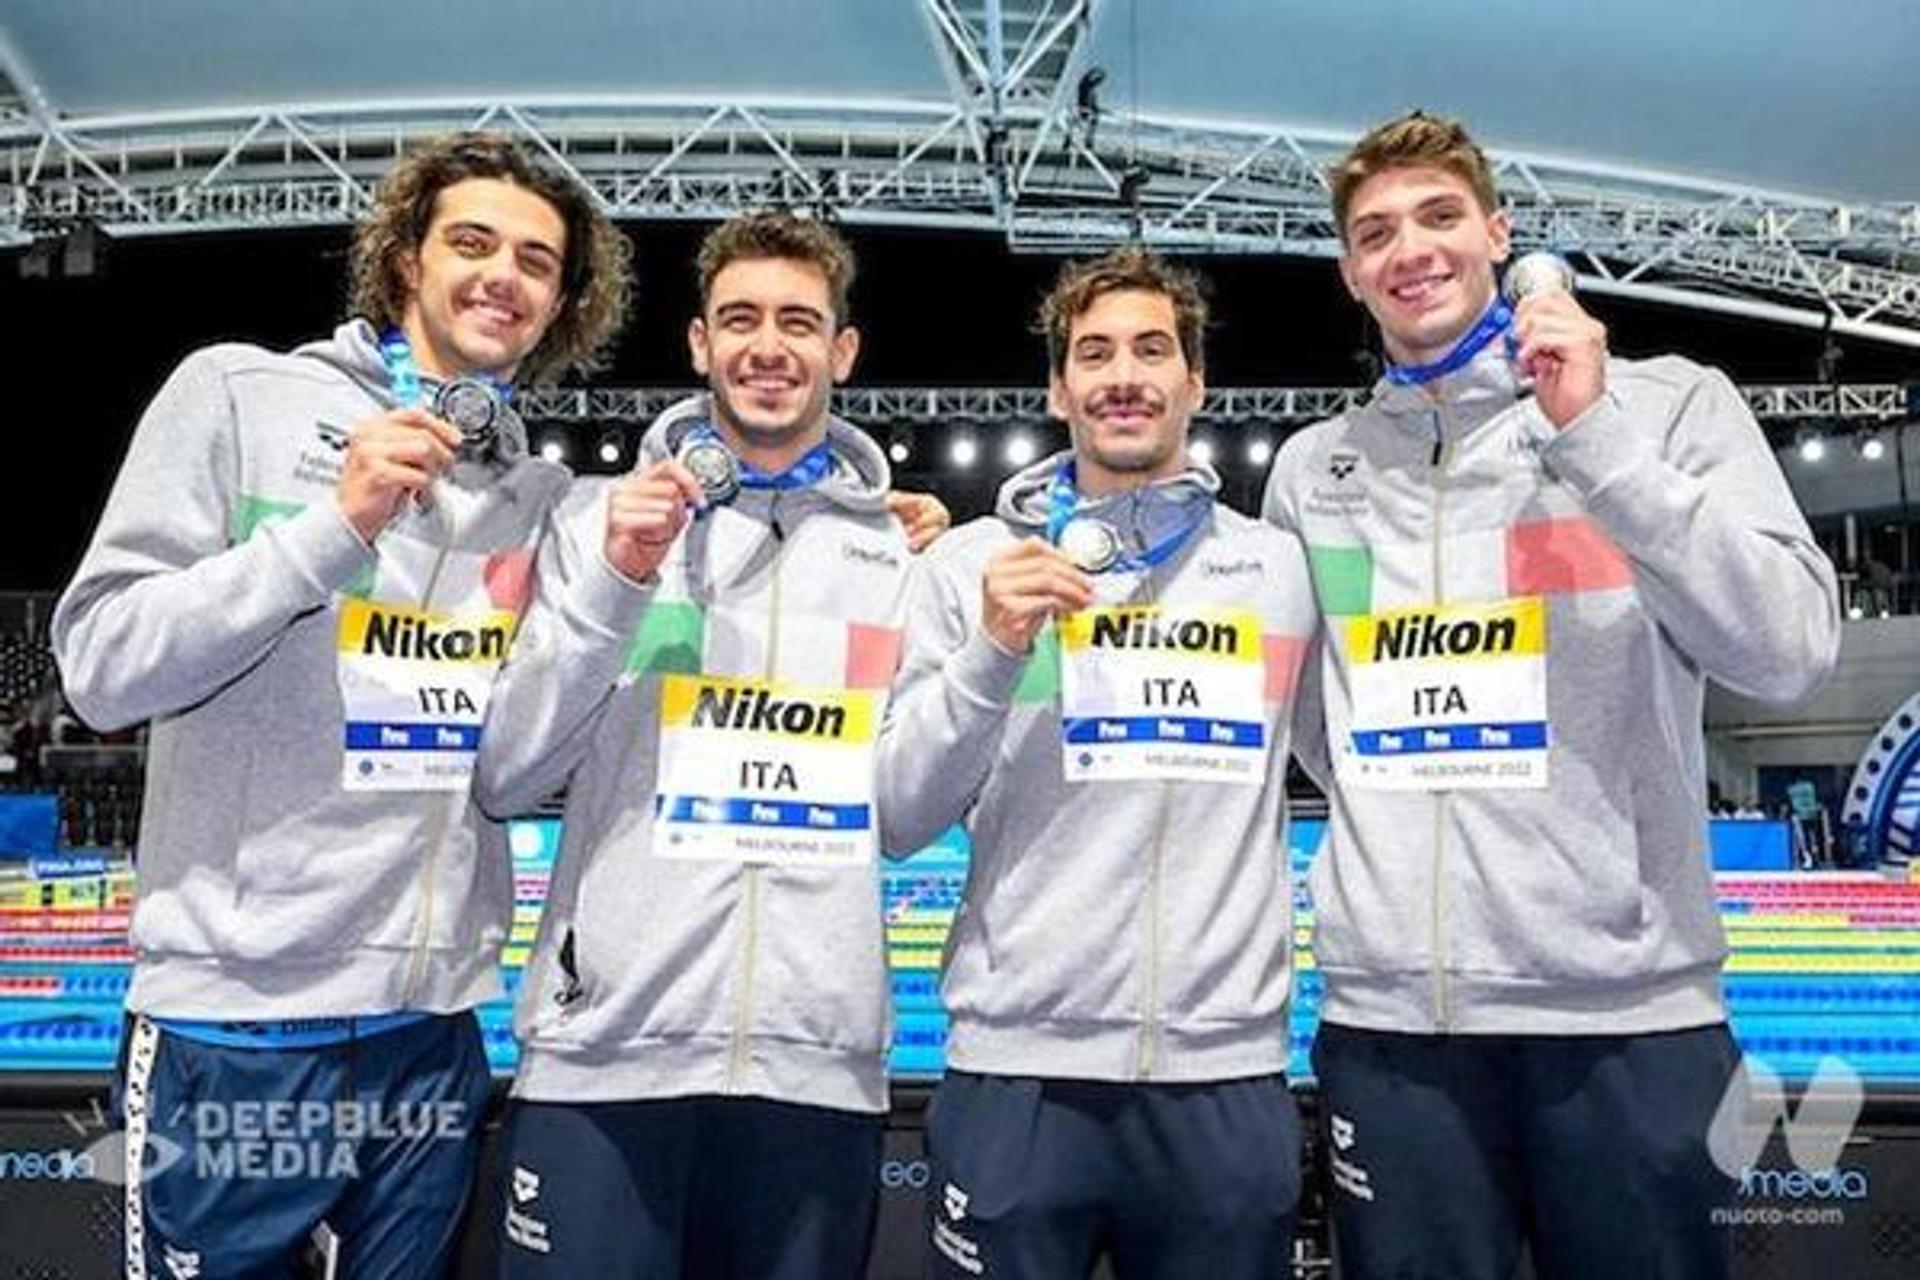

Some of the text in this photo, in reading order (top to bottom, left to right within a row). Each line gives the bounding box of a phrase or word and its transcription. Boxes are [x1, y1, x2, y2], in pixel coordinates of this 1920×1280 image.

[363, 611, 505, 661] Nikon
[1091, 613, 1238, 655] Nikon
[1373, 614, 1516, 662] Nikon
[417, 686, 478, 715] ITA
[1143, 677, 1200, 707] ITA
[1413, 684, 1469, 717] ITA
[691, 685, 847, 738] Nikon
[739, 761, 799, 791] ITA
